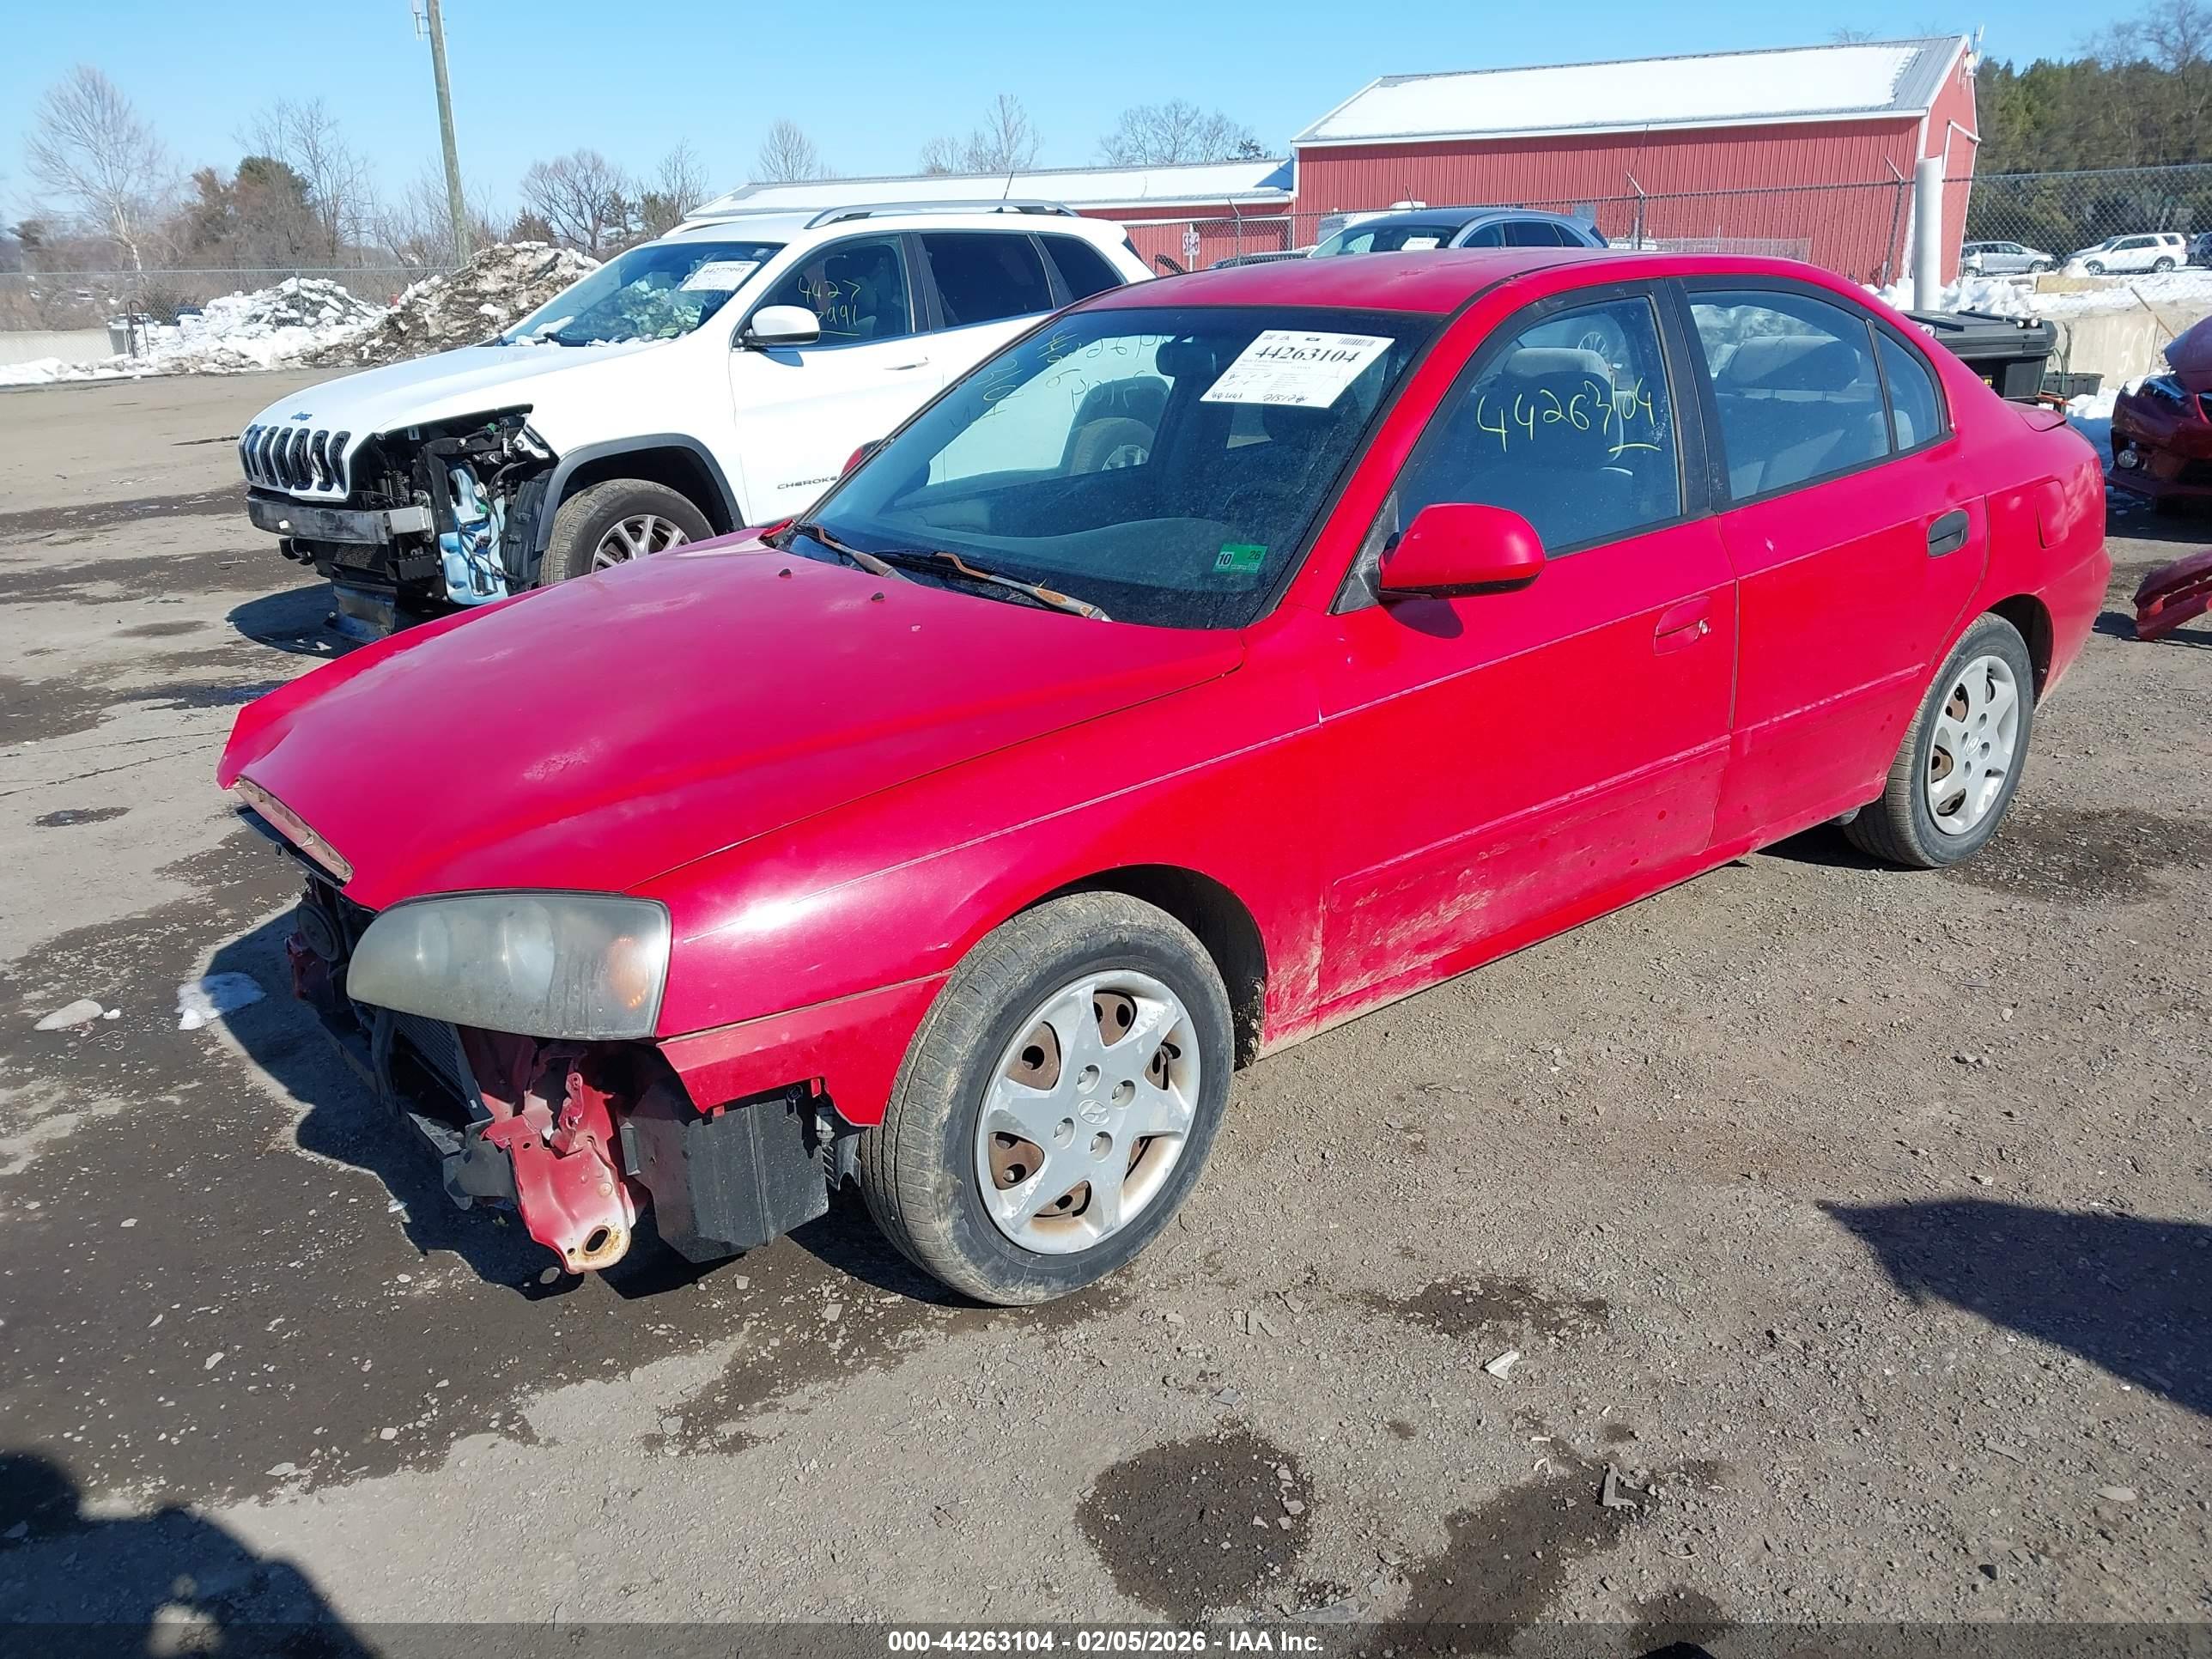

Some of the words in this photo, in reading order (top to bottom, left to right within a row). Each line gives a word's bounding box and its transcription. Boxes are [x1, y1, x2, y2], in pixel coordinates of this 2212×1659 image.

[1255, 345, 1361, 362] 44263104
[1477, 377, 1656, 453] 44263104
[777, 476, 842, 489] CHEROKE
[1219, 554, 1231, 565] 10
[1249, 550, 1261, 560] 26
